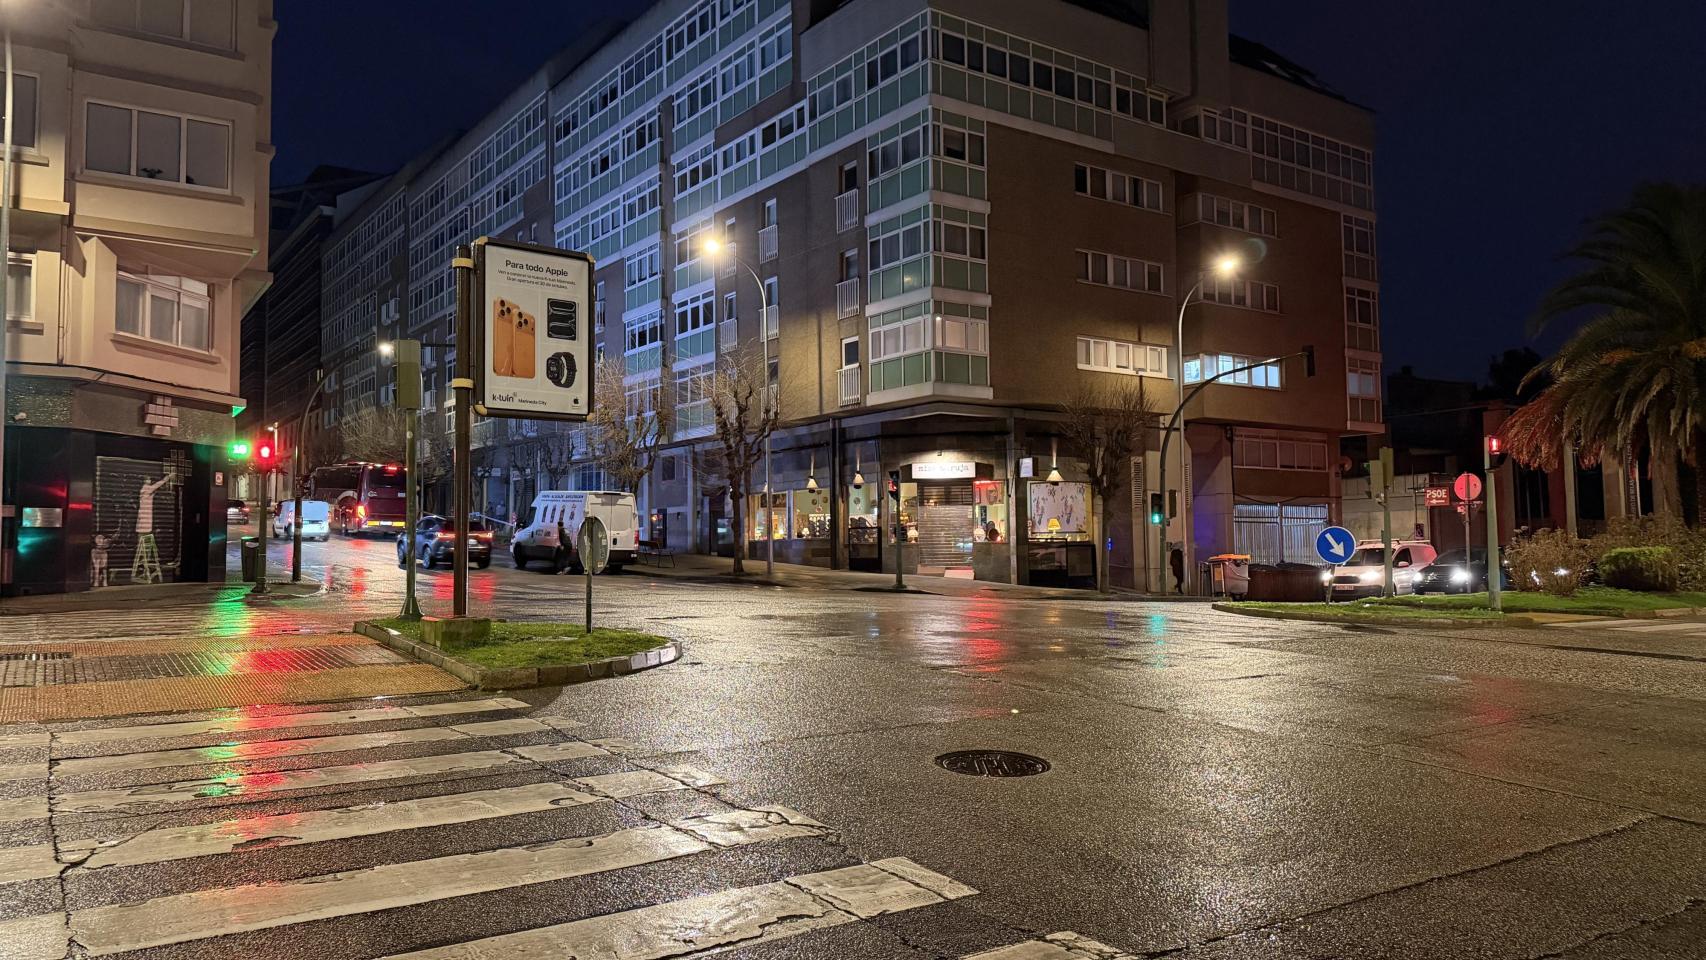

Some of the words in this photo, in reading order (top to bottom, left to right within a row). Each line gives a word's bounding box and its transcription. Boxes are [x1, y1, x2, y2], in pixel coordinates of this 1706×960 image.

[506, 259, 524, 270] Para
[525, 263, 544, 273] todo
[545, 266, 569, 277] Apple
[1426, 489, 1447, 499] PSOE
